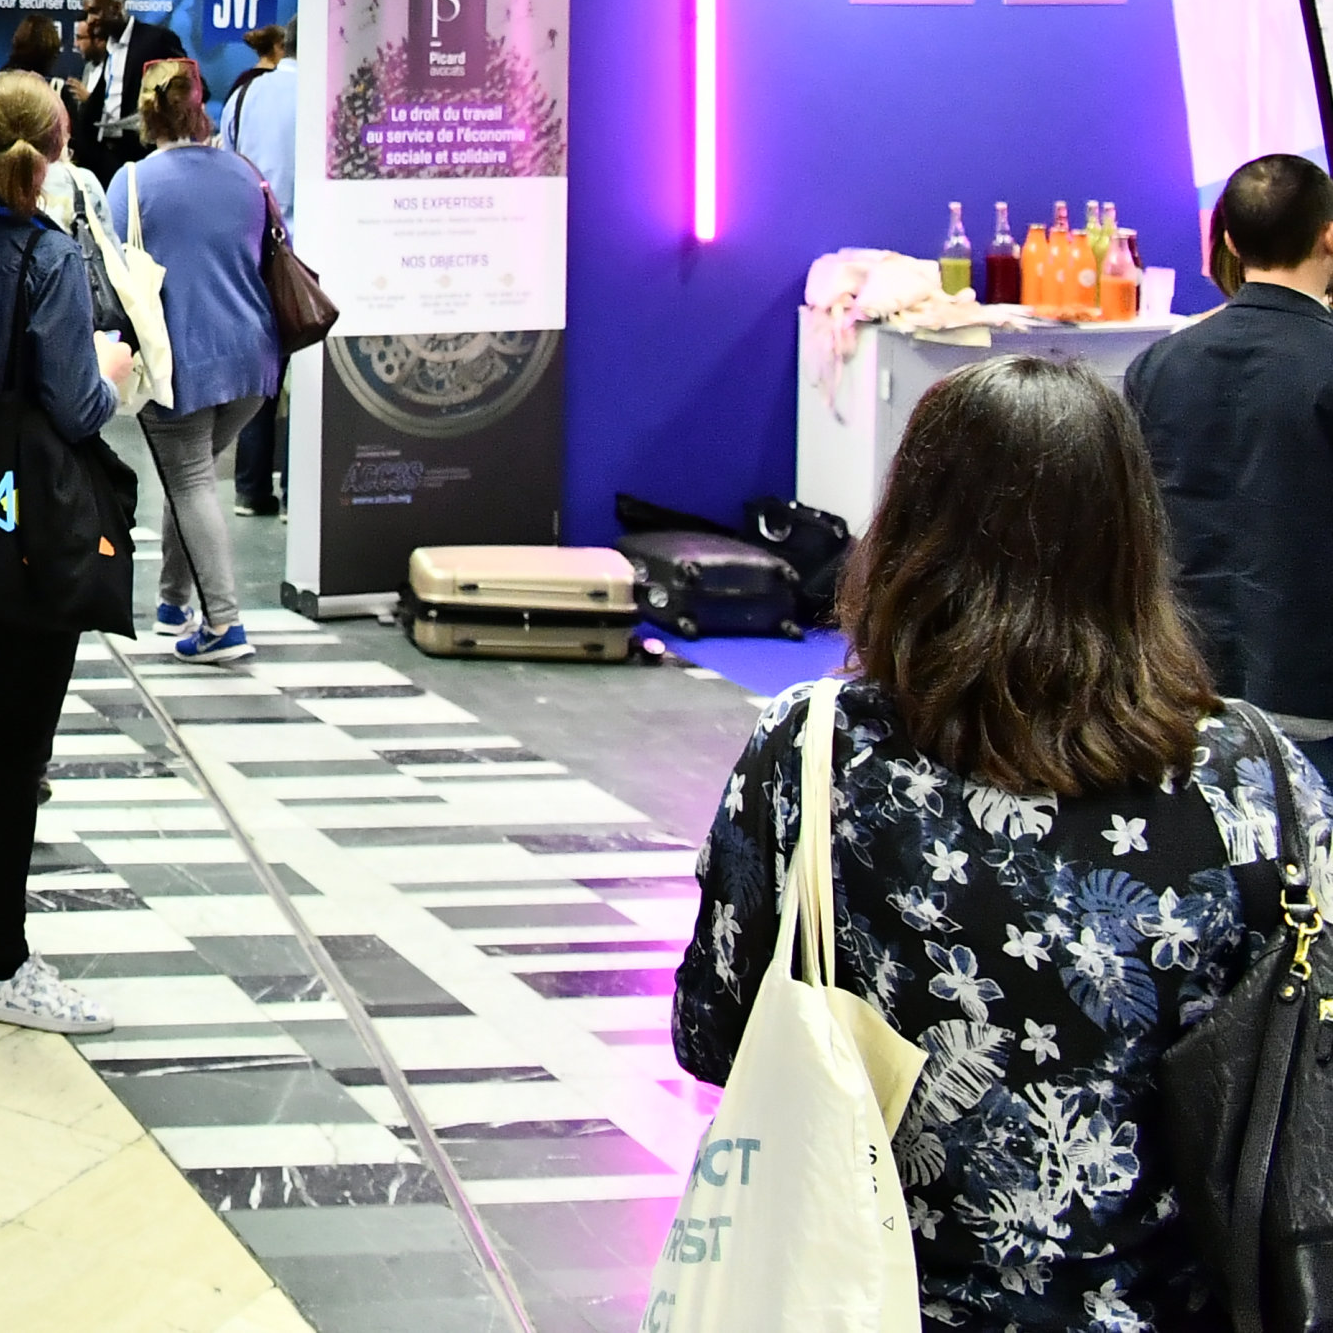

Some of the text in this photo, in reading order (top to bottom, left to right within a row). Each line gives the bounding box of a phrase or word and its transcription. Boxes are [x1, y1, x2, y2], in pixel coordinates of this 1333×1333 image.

[124, 0, 173, 13] missions
[429, 51, 466, 65] Picard
[429, 67, 466, 77] avocats
[390, 104, 503, 122] Le droit du travail
[366, 127, 526, 144] au service de l'économie
[385, 148, 507, 165] sociale et solidaire
[393, 196, 494, 211] NOS EXPERTISES
[401, 254, 490, 270] NOS OBJECTIFS
[691, 1137, 761, 1192] CT
